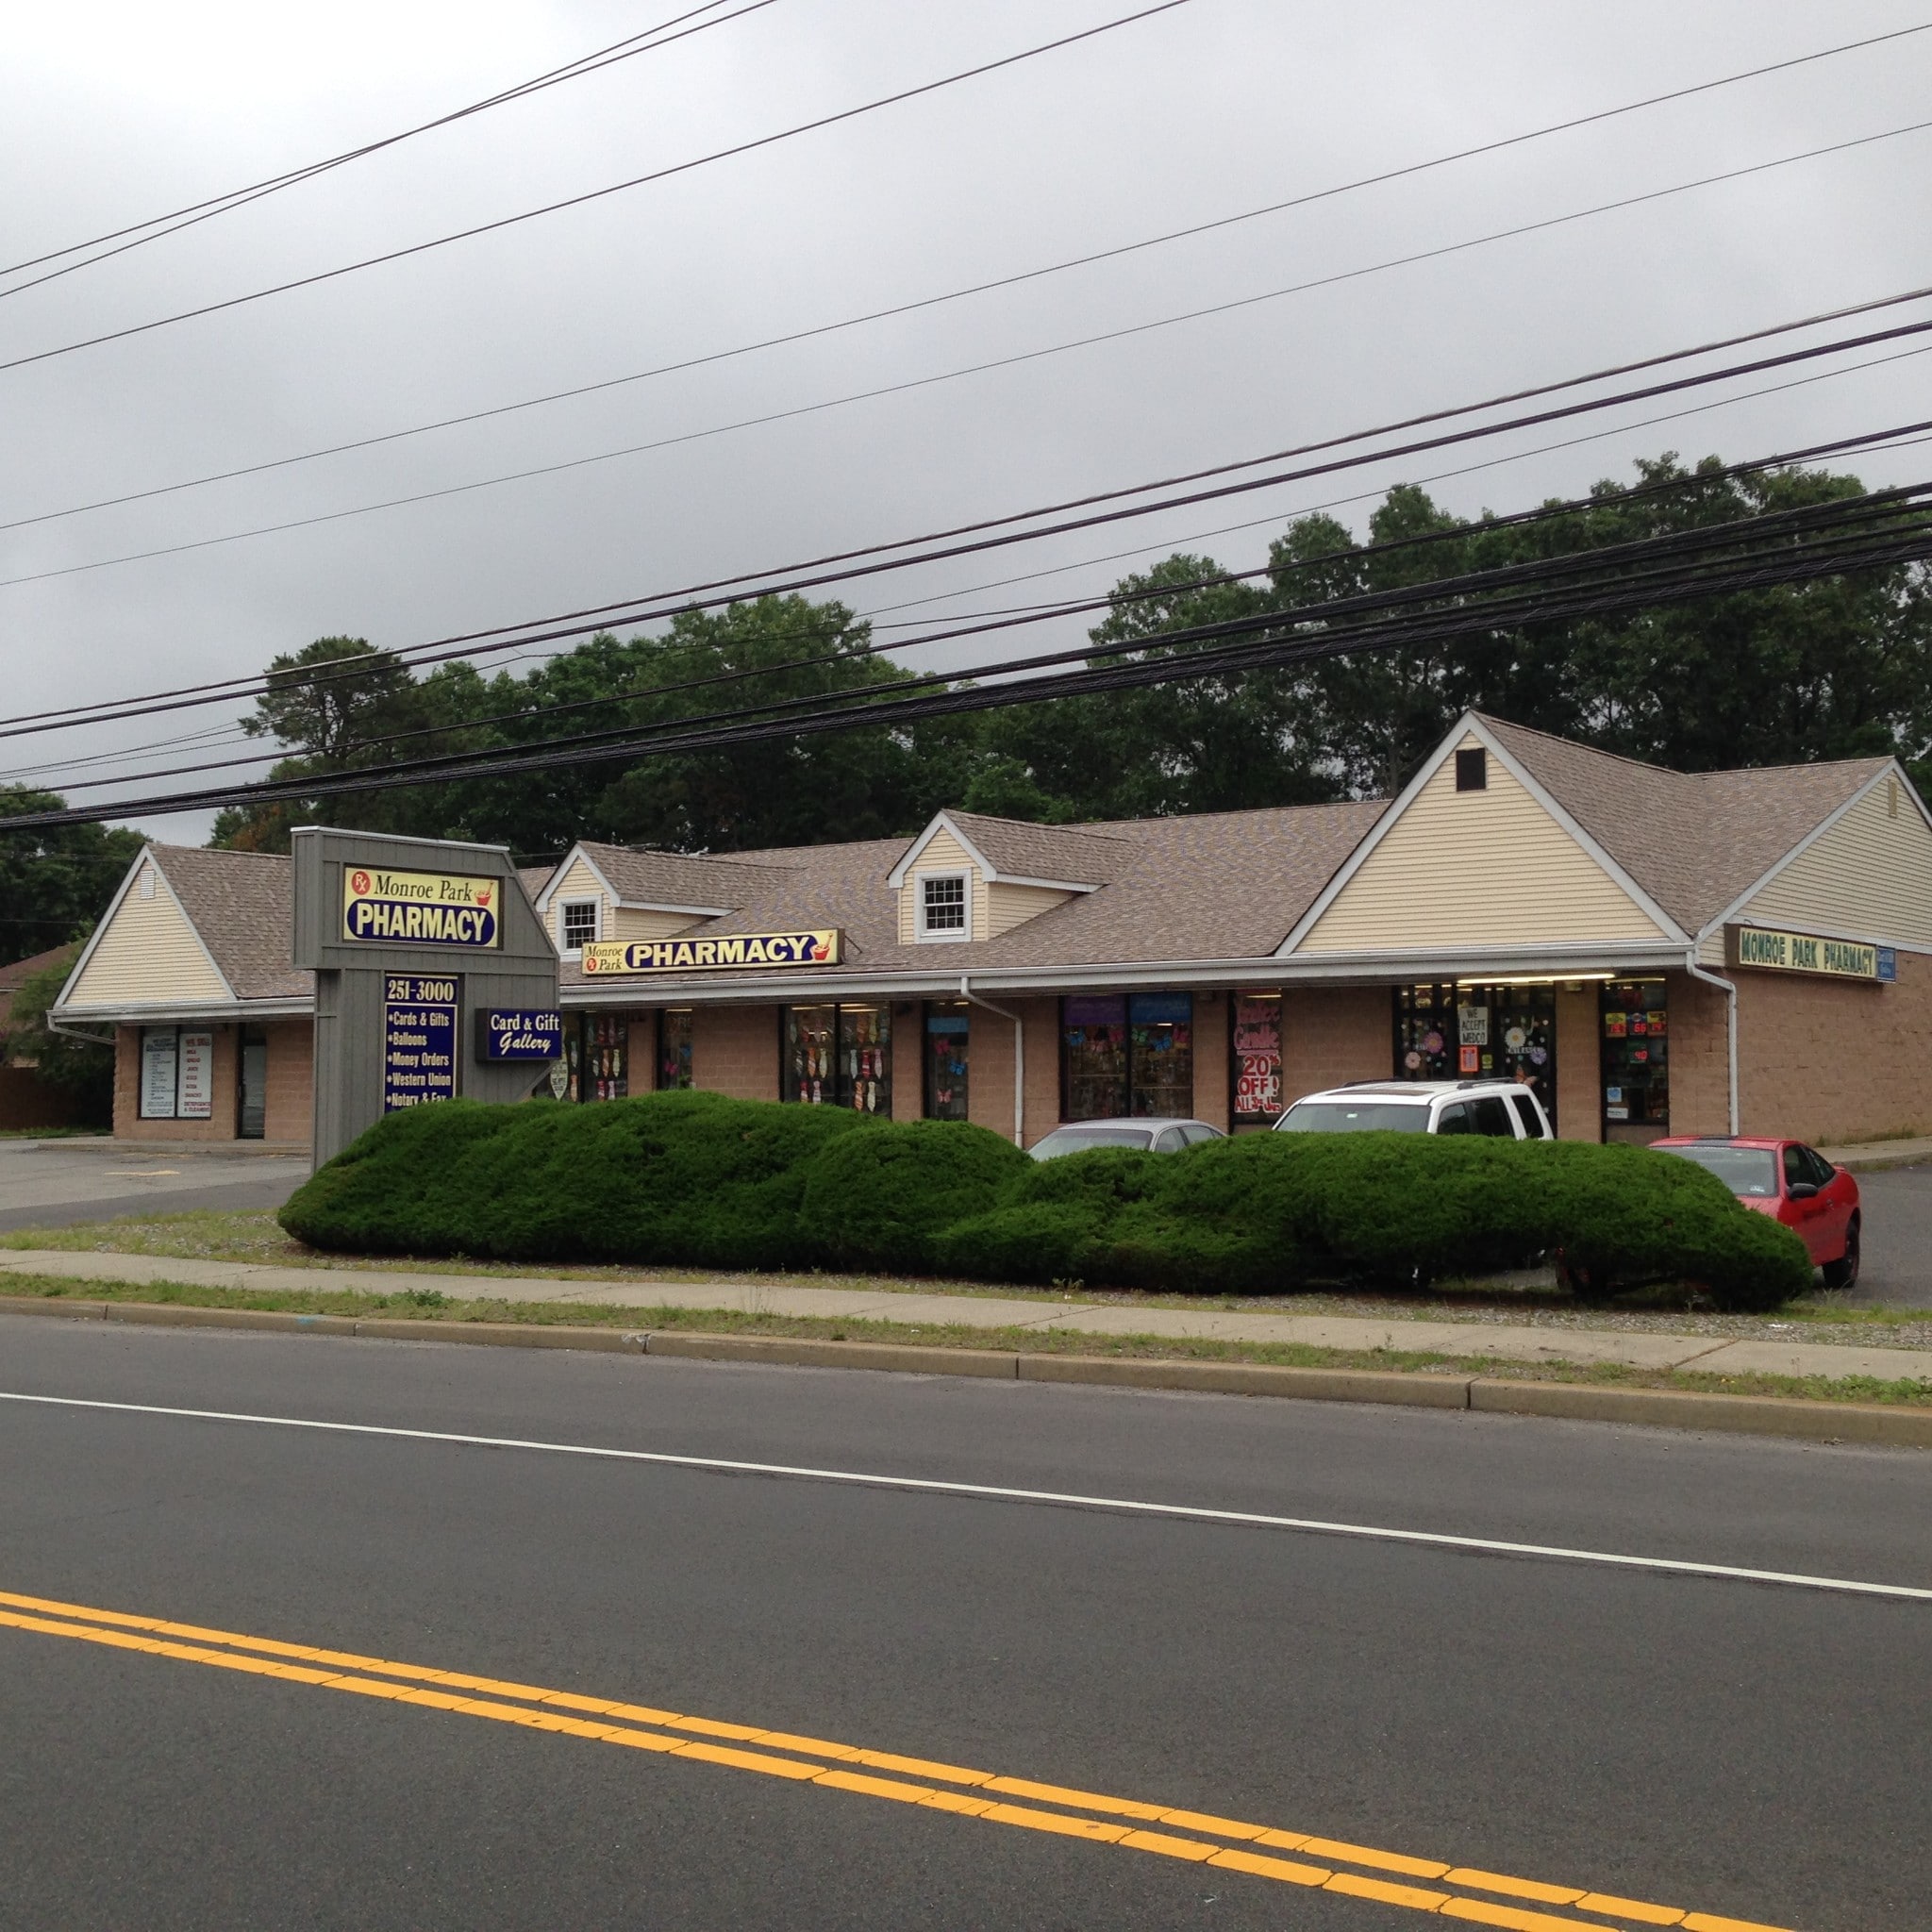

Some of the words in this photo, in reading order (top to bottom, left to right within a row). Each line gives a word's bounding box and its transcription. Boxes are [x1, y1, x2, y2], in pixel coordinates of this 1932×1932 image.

[374, 874, 434, 899] Monroe
[439, 880, 474, 902] Park
[356, 902, 488, 941] PHARMACY
[586, 945, 623, 958] Monroe
[632, 937, 810, 968] PHARMACY
[1741, 930, 1786, 965] MONROE
[1792, 938, 1819, 969] PARK
[1824, 942, 1874, 975] PHARMACY
[598, 958, 623, 971] Park
[388, 979, 455, 1002] 251-3000
[393, 1011, 417, 1025] Cards
[420, 1012, 427, 1026] &
[429, 1012, 450, 1027] Gifts
[491, 1013, 521, 1031] Card
[524, 1017, 532, 1030] &
[535, 1013, 560, 1031] Gift
[392, 1031, 427, 1046] Balloons
[499, 1031, 552, 1056] Gallery
[391, 1052, 419, 1068] Money
[422, 1052, 450, 1067] Orders
[391, 1072, 425, 1087] Western
[428, 1073, 452, 1086] Union
